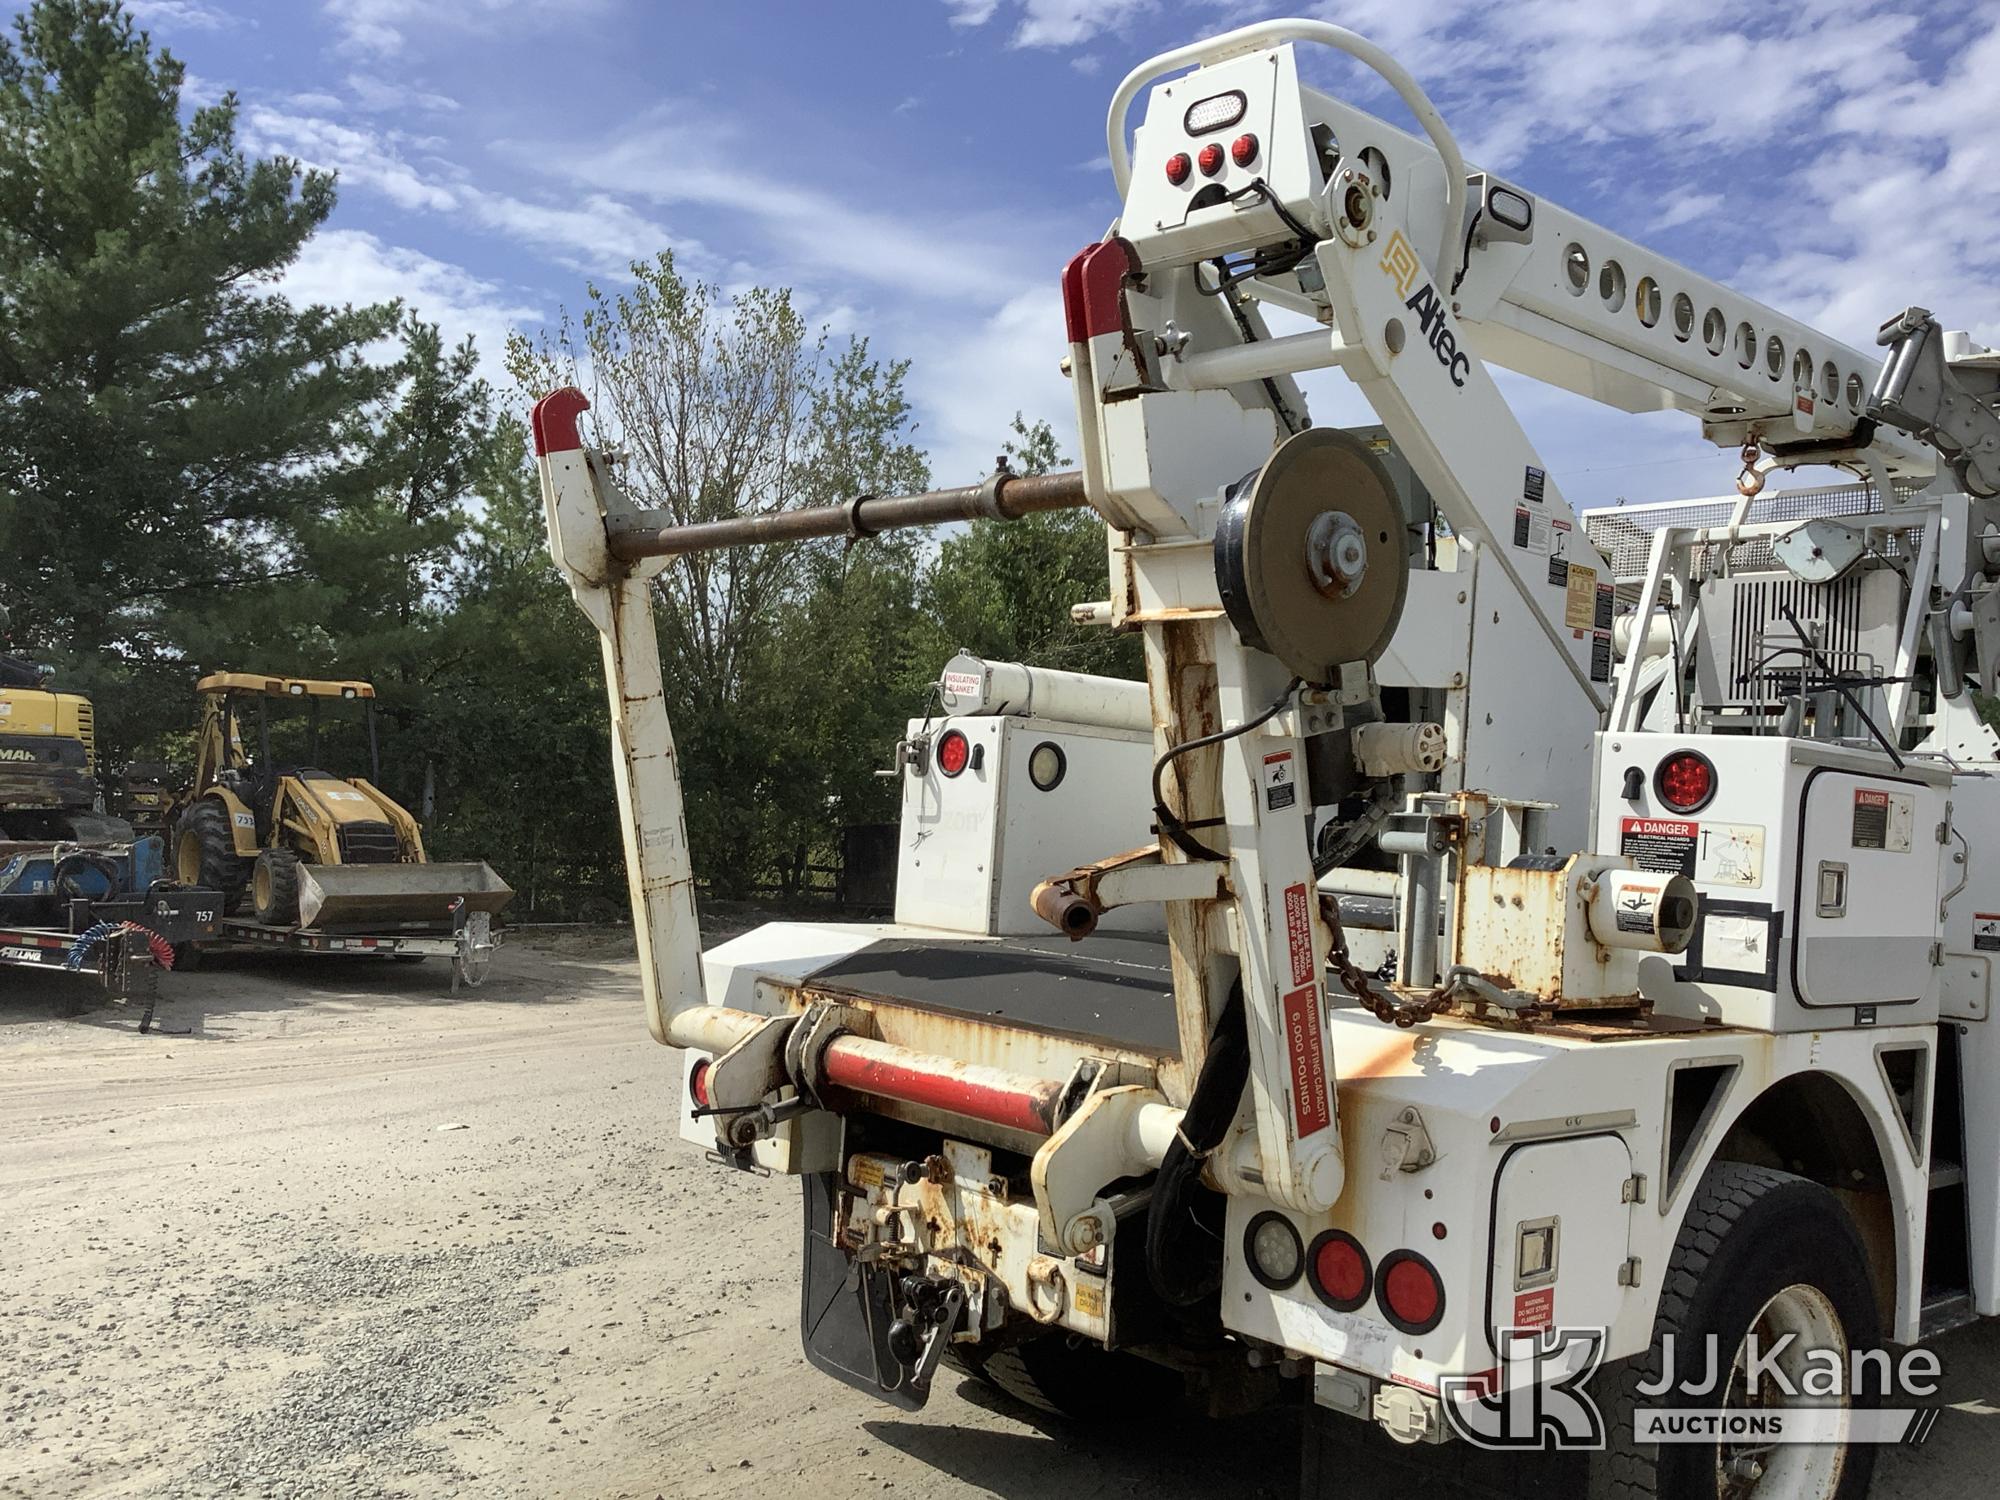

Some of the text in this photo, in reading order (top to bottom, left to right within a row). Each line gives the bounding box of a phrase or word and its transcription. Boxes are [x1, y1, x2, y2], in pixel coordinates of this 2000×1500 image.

[1405, 283, 1470, 387] Altec
[947, 674, 980, 685] INSULATING
[1643, 822, 1690, 835] DANGER
[195, 911, 213, 922] 757
[1300, 895, 1308, 931] MAXIMUM
[1286, 891, 1294, 910] 1000
[1293, 956, 1301, 984] RADIUS
[1299, 947, 1307, 978] TORQUE
[1292, 1011, 1311, 1116] 6,000 POUNDS
[1305, 990, 1327, 1123] MAXIMUM LIFTING CAPACITY
